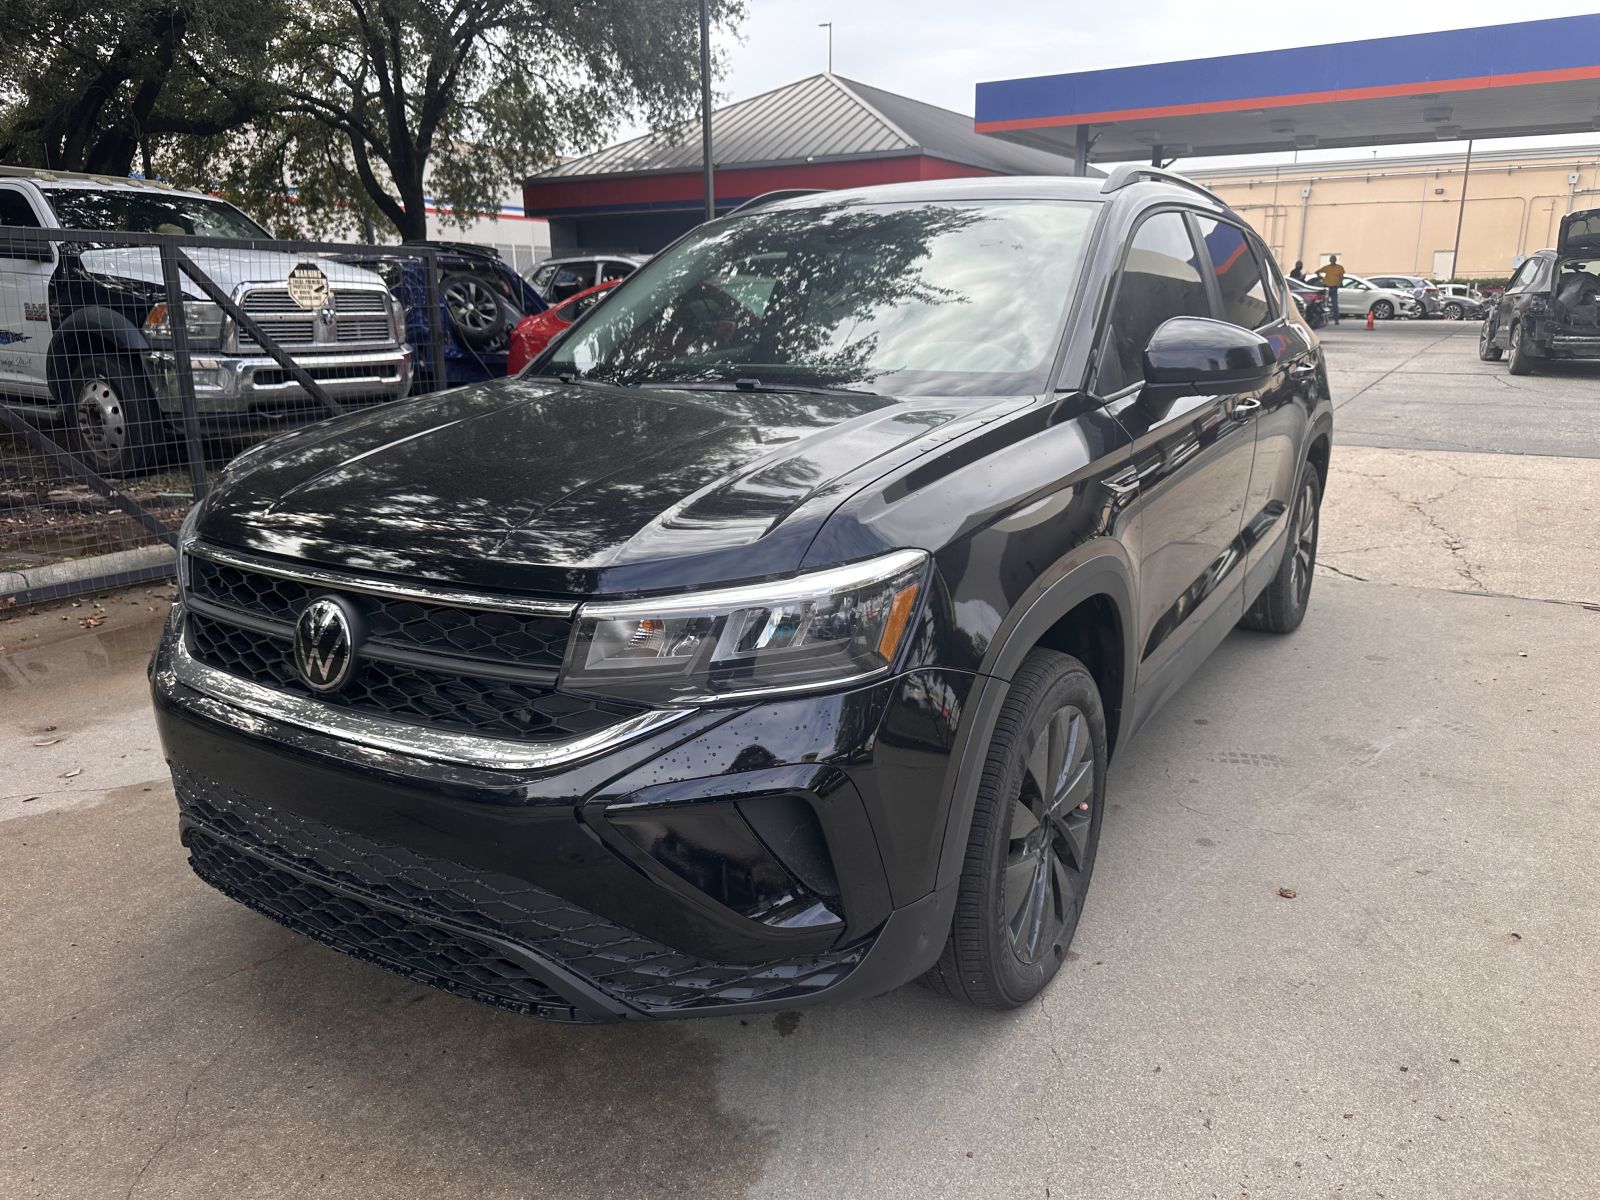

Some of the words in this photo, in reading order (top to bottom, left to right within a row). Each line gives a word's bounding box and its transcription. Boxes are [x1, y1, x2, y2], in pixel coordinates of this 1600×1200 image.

[294, 269, 322, 278] WARNING
[24, 302, 47, 310] RAM
[296, 601, 350, 685] VW
